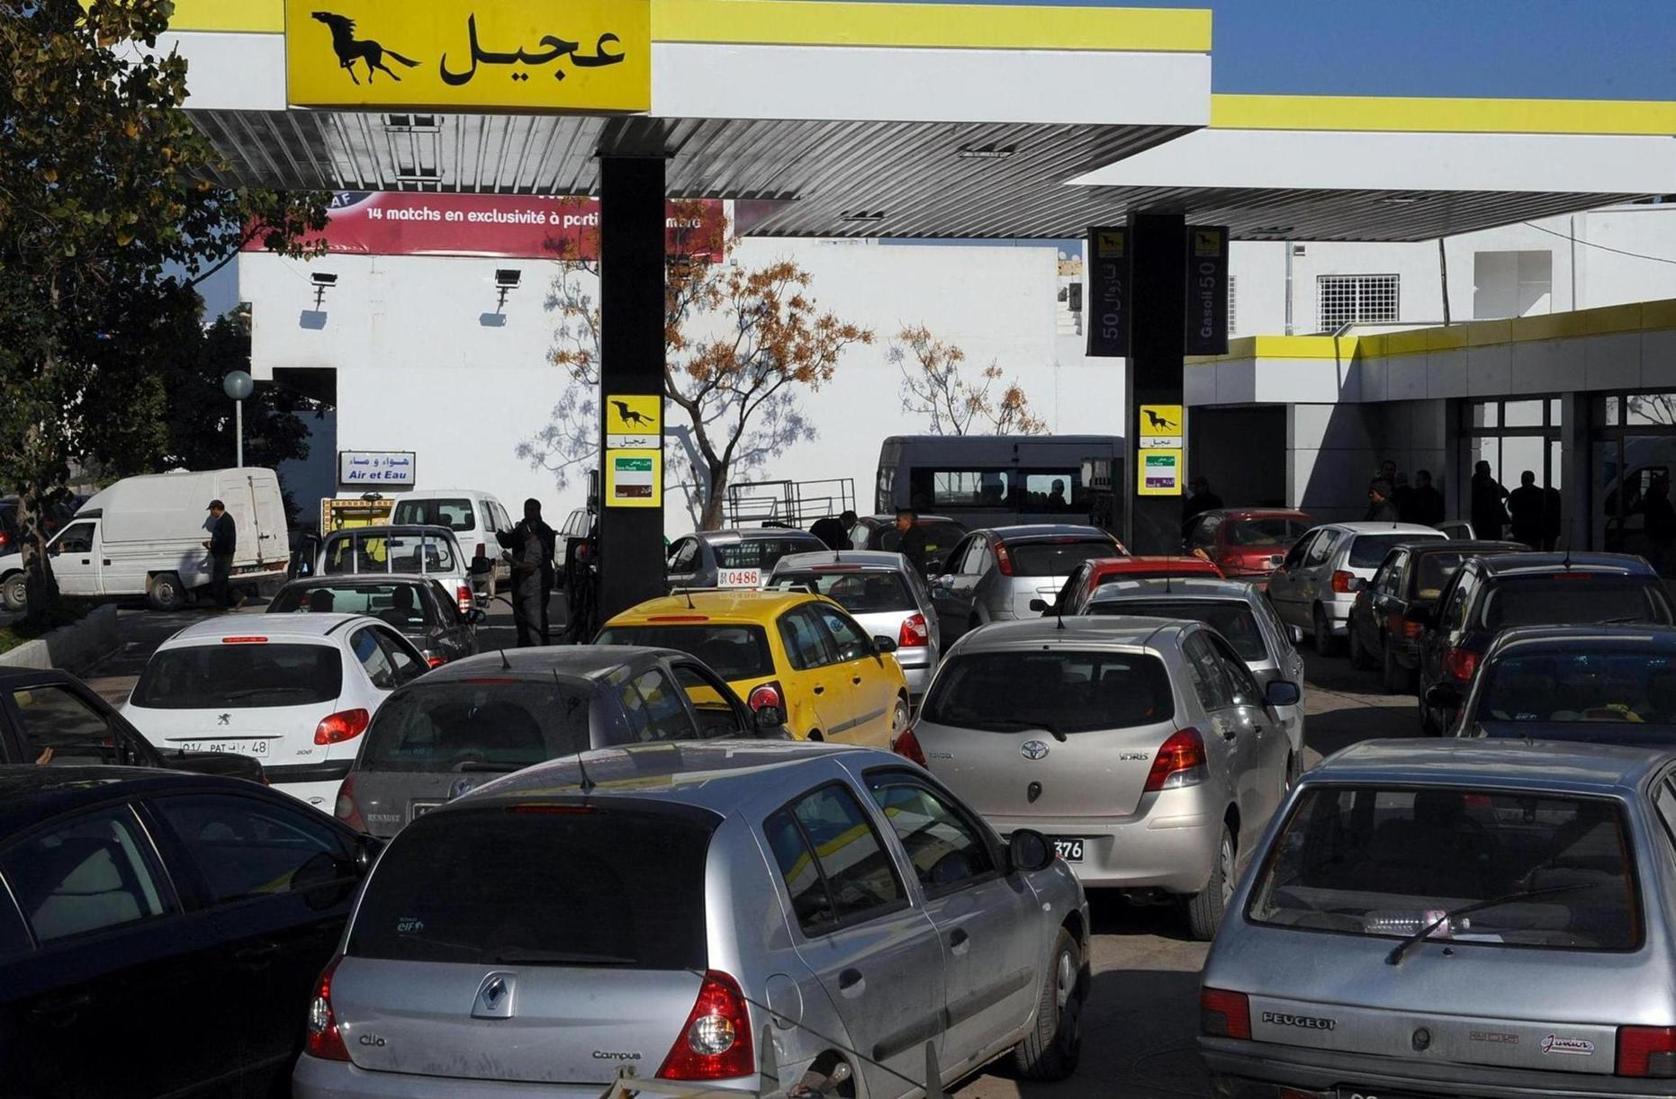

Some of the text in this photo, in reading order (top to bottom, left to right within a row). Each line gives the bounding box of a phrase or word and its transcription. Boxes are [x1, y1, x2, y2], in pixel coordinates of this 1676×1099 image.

[439, 12, 626, 86] عجيل
[367, 207, 382, 220] 14
[387, 207, 441, 221] matchs
[445, 210, 464, 222] en
[468, 209, 546, 224] exclusivité
[550, 211, 560, 225] à
[1199, 262, 1216, 338] Gasoil 50
[1102, 312, 1120, 340] 50
[348, 470, 407, 480] Air et Eau
[728, 570, 758, 585] 0486
[210, 744, 226, 752] PAT
[251, 741, 267, 753] 48
[1054, 841, 1082, 858] 376
[1262, 1011, 1337, 1031] PEUGEOT
[1542, 1034, 1589, 1054] Junior
[592, 1050, 642, 1061] Campus
